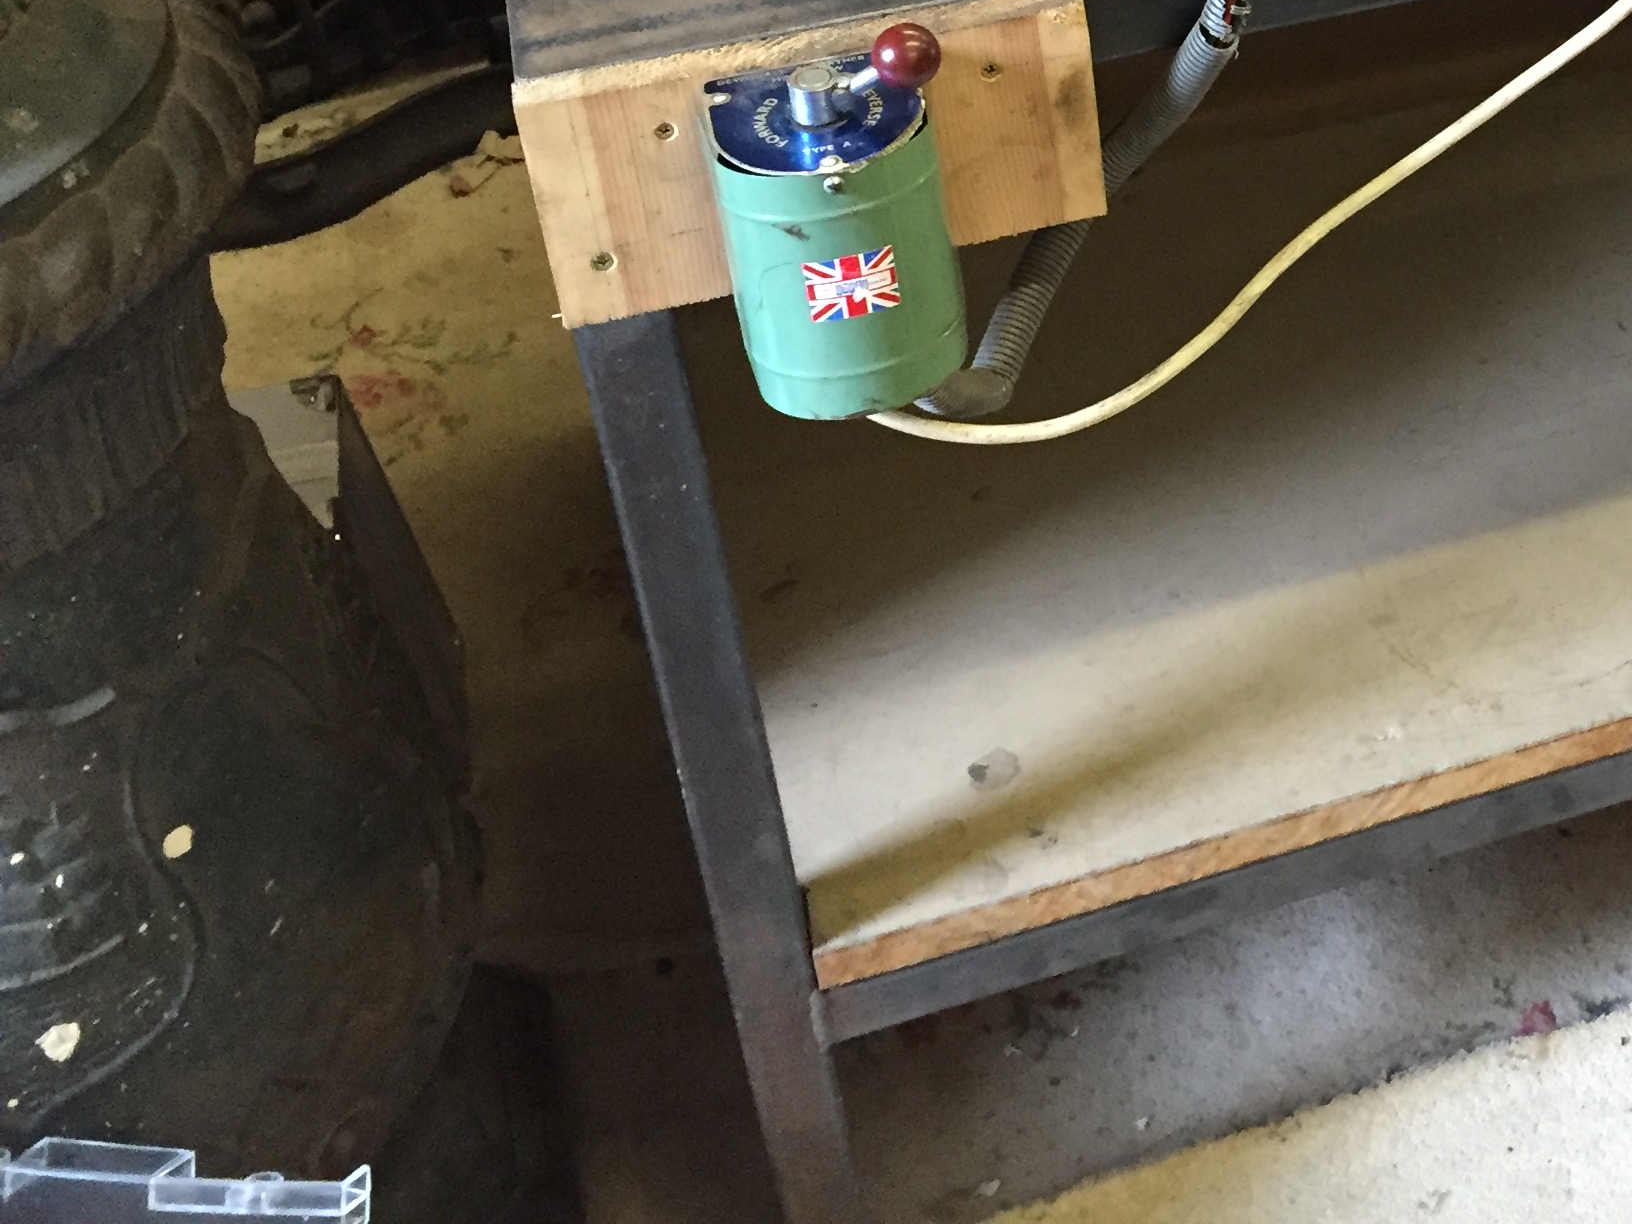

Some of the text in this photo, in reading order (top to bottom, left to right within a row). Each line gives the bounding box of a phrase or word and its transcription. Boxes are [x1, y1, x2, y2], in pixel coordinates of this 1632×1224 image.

[751, 96, 790, 149] FORWARD
[862, 87, 884, 127] EVERSE
[802, 144, 835, 155] TYPE
